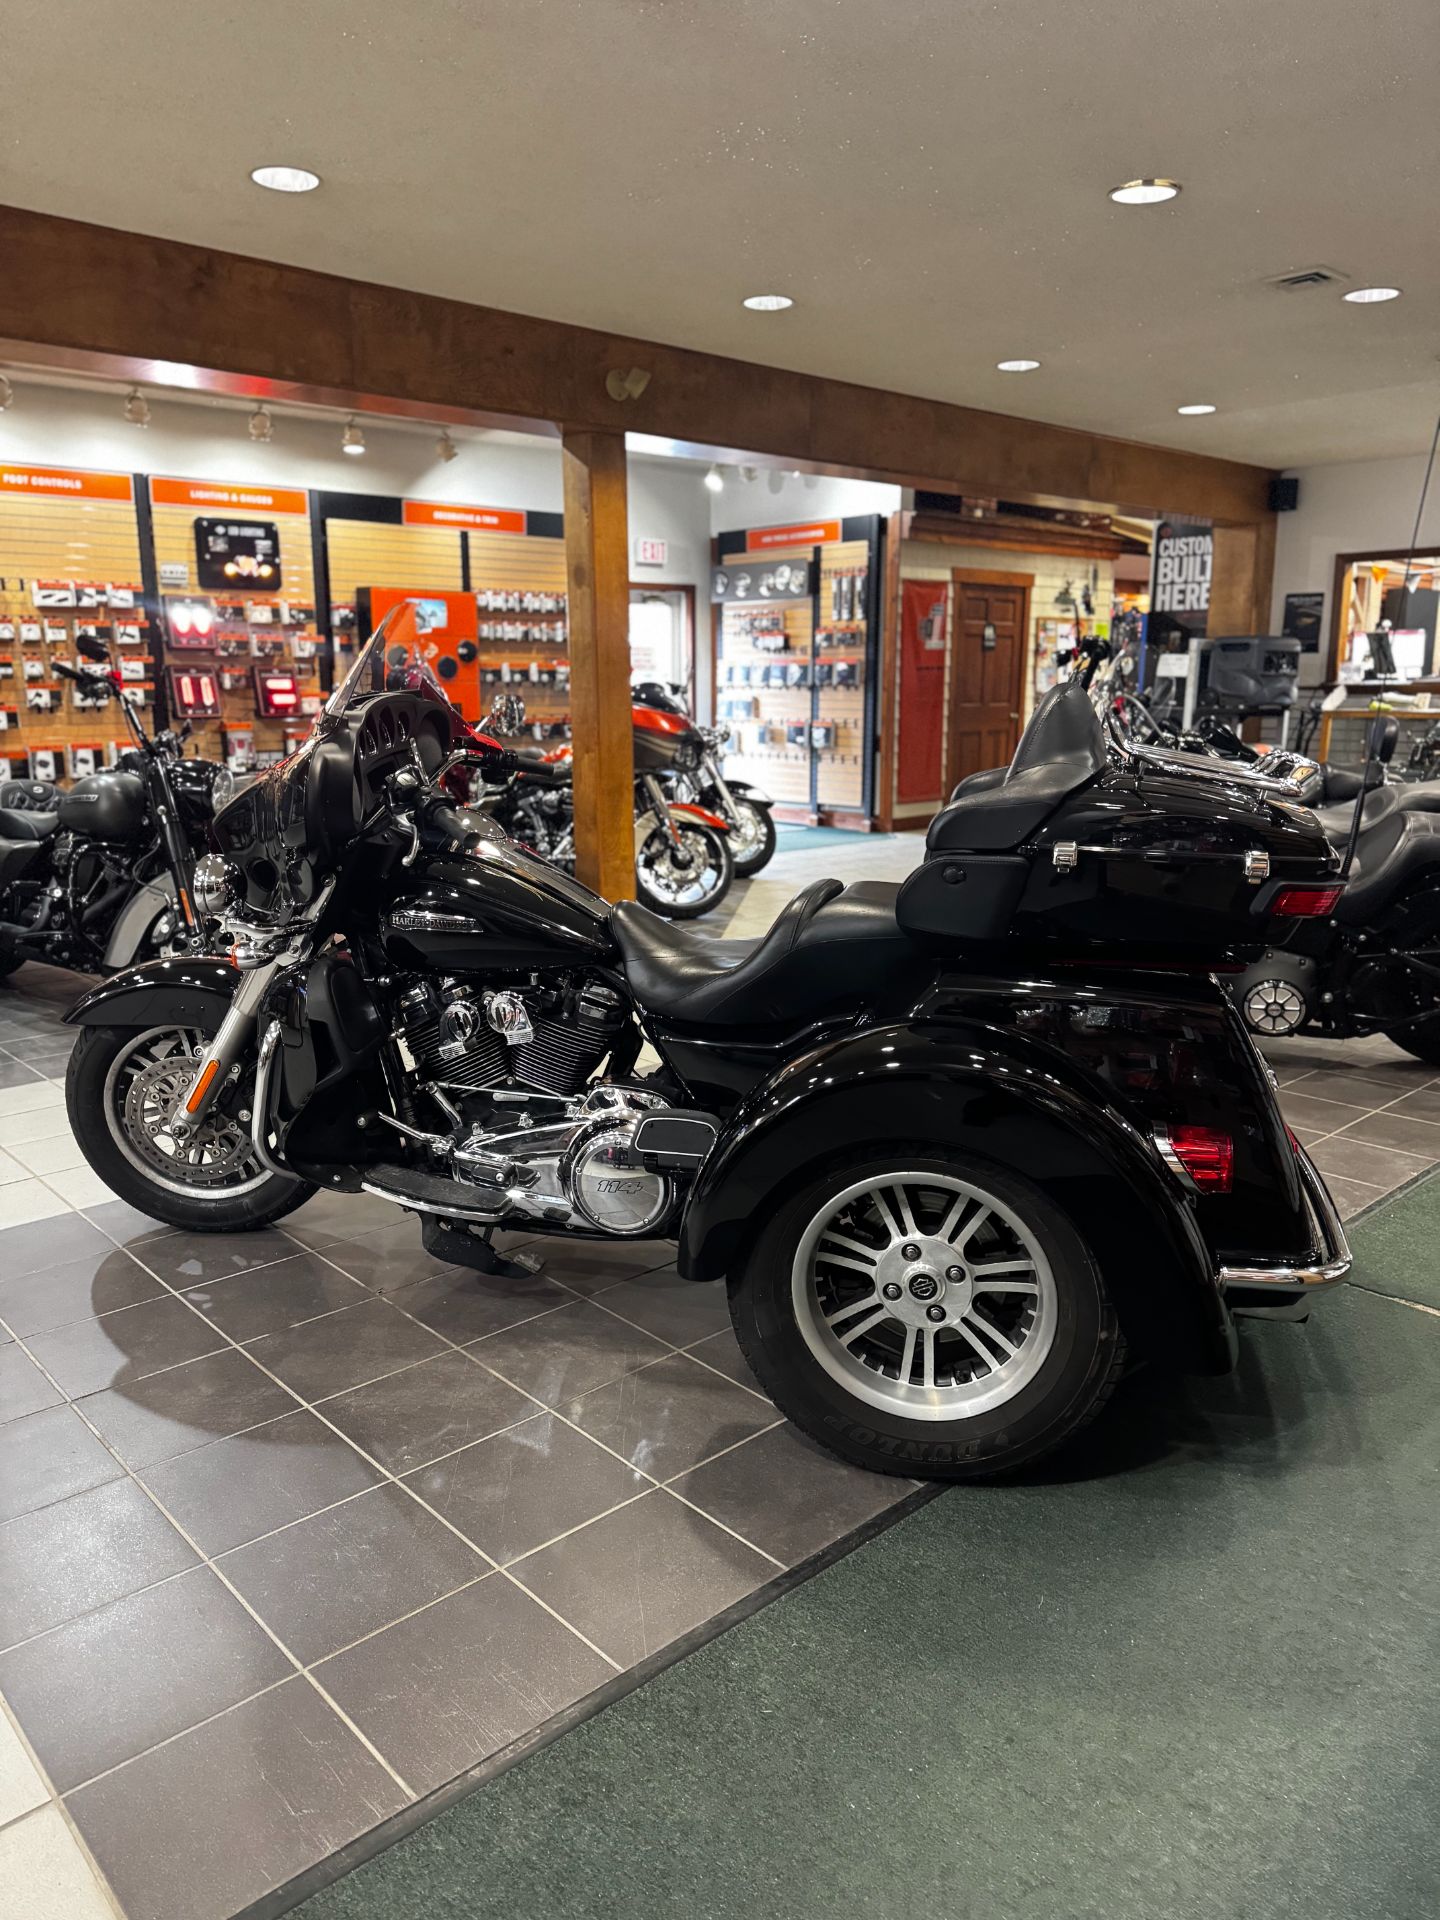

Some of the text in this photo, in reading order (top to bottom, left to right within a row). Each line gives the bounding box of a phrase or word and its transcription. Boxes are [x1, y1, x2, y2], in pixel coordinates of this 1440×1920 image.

[3, 474, 82, 489] FOOT CONTROLS
[641, 541, 666, 560] EXIT
[1157, 554, 1213, 584] BUILT
[1155, 582, 1210, 612] HERE
[597, 1179, 644, 1195] 114
[823, 1415, 981, 1464] DUNLOP
